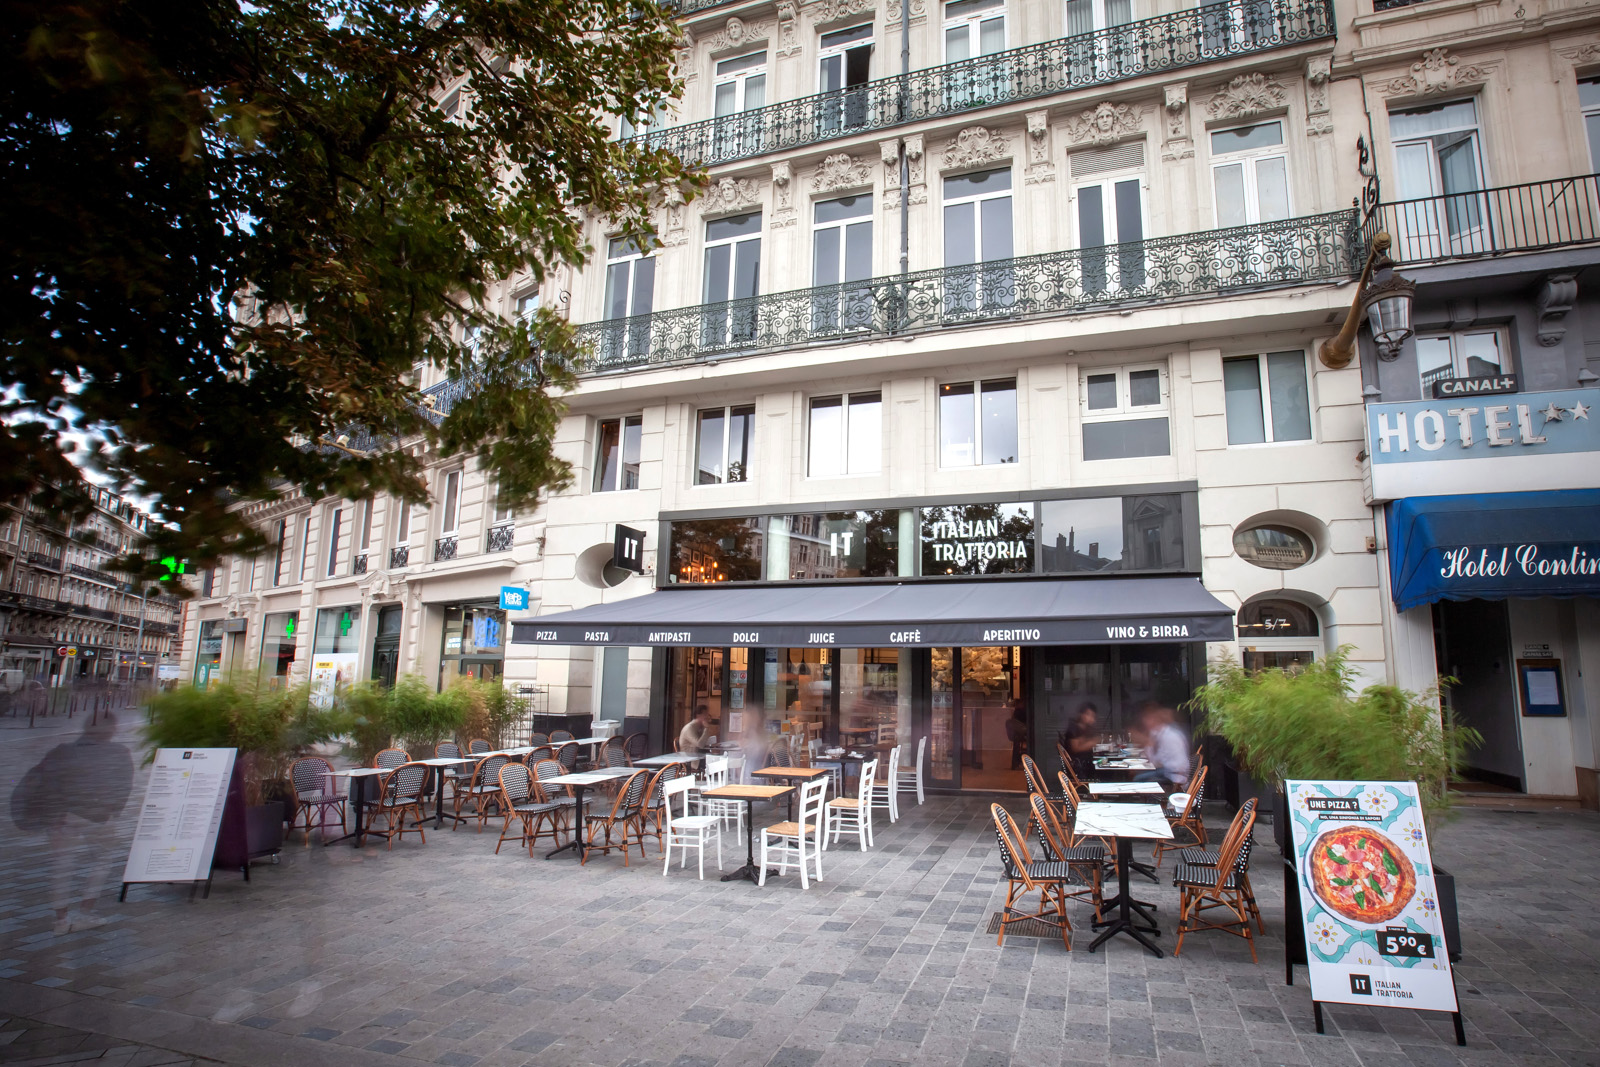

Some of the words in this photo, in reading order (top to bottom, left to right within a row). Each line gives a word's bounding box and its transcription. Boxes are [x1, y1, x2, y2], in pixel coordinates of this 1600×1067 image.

[1441, 378, 1514, 394] CANAL+
[1377, 404, 1548, 453] HOTEL
[932, 519, 998, 539] ITALIAN
[624, 537, 638, 560] IT
[830, 532, 853, 556] IT
[932, 540, 1028, 562] TRATTORIA
[1440, 546, 1512, 579] Hotel
[1264, 618, 1287, 631] 5/7
[536, 631, 557, 641] PIZZA
[584, 632, 609, 642] PASTA
[648, 632, 691, 642] ANTIPASTI
[733, 632, 759, 643] DOLCI
[889, 629, 921, 643] CAFFÈ
[983, 629, 1041, 641] APERITIVO
[1106, 626, 1136, 638] VINO
[1138, 626, 1149, 638] &
[1152, 625, 1189, 637] BIRRA
[808, 633, 835, 643] JUICE
[1309, 800, 1327, 808] UNE
[1328, 801, 1351, 809] PIZZA
[1352, 801, 1358, 809] ?
[1355, 979, 1366, 990] IT
[1374, 980, 1401, 989] ITALIAN
[1376, 989, 1414, 999] TRATTORIA
